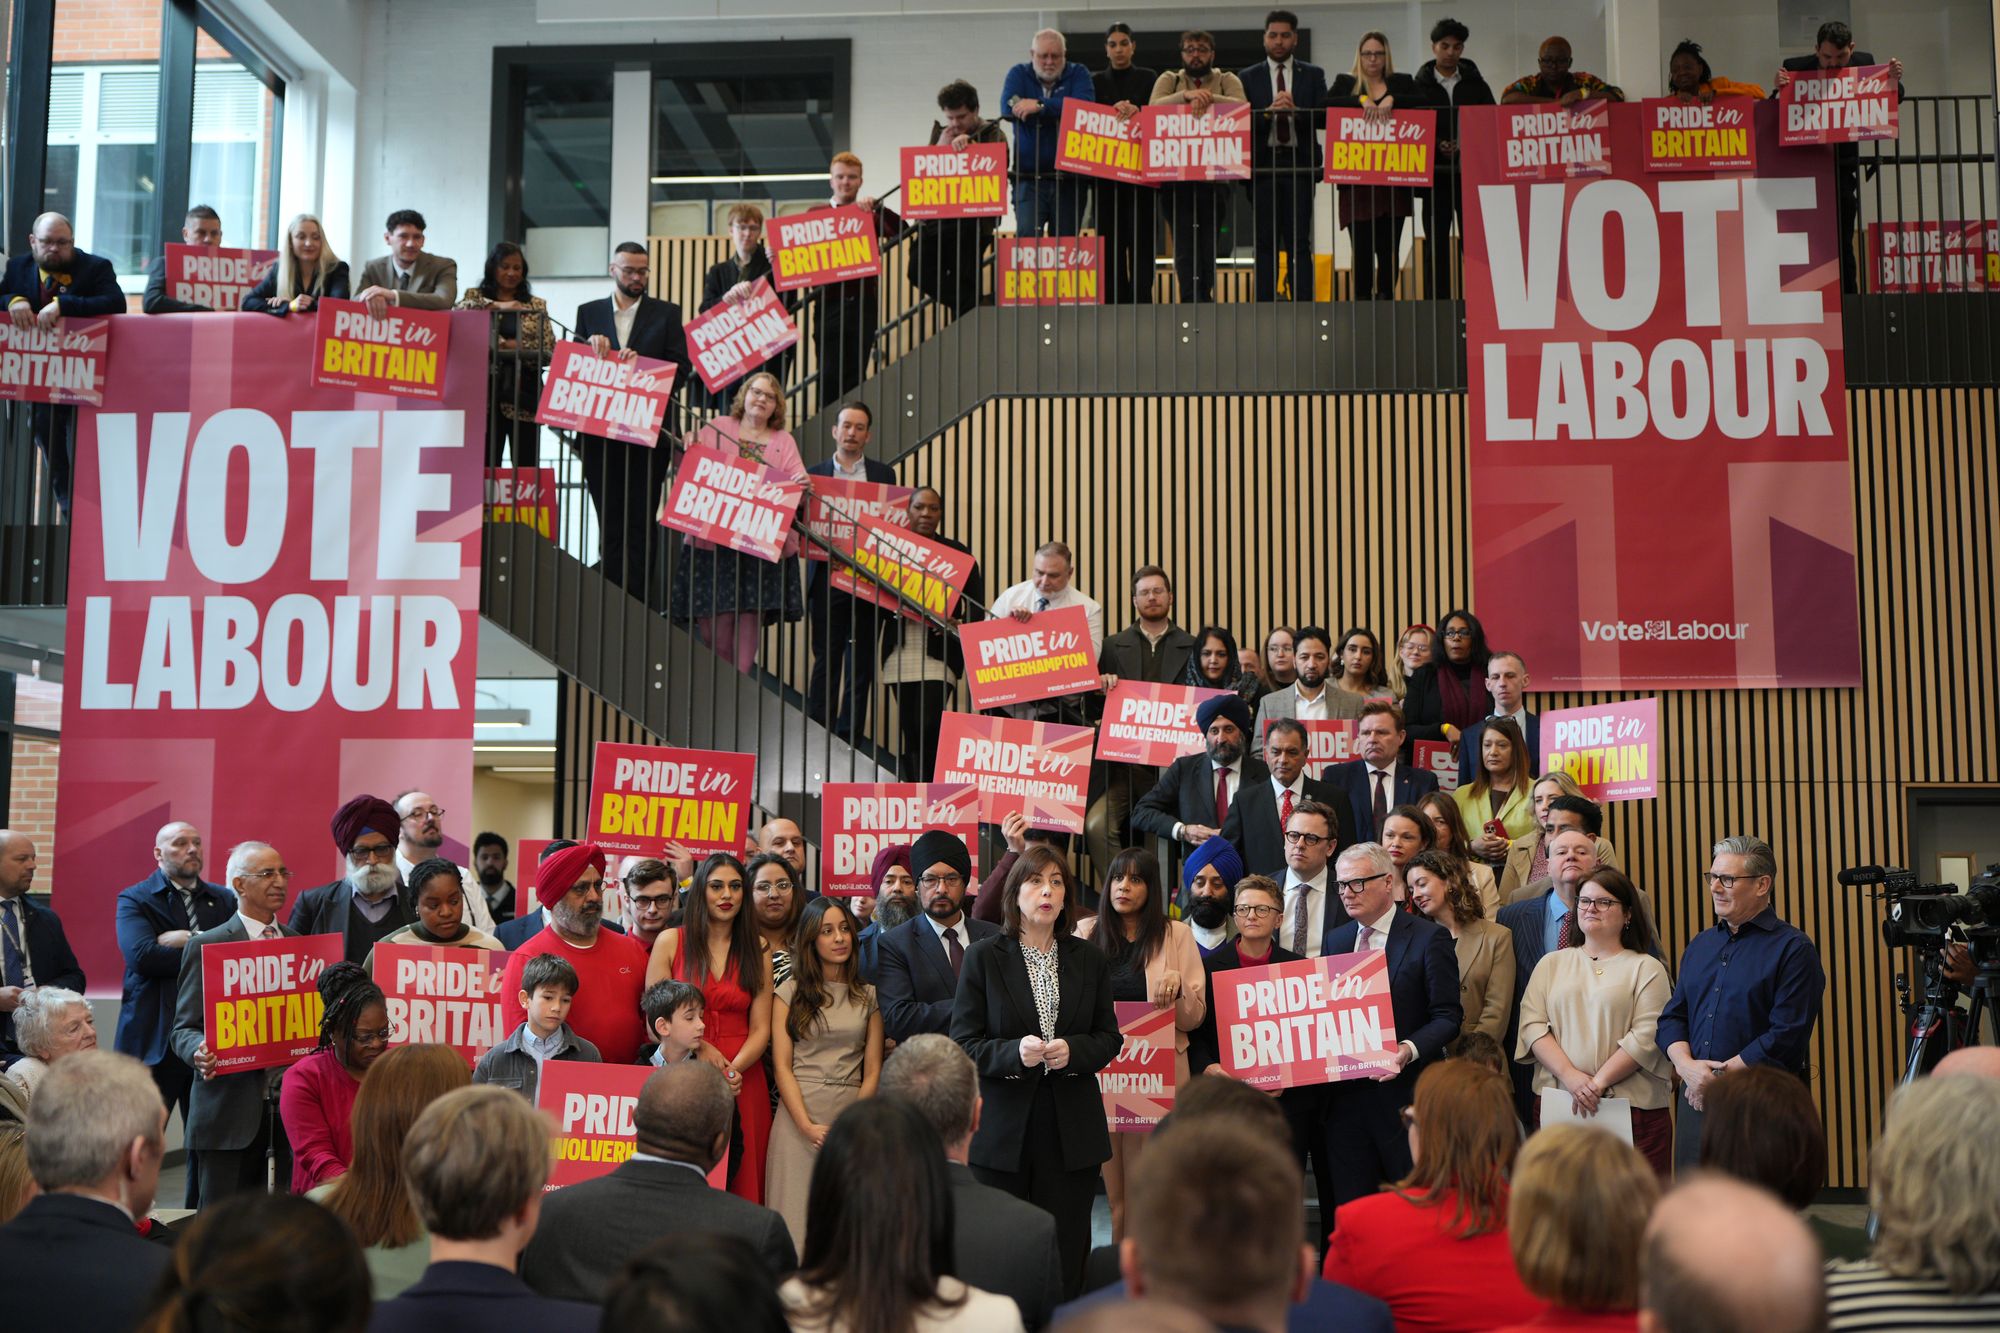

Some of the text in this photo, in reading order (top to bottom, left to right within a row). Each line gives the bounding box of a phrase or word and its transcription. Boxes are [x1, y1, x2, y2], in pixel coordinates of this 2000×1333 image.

[1794, 76, 1886, 102] PRIDE in
[1074, 108, 1142, 140] PRIDE i
[1156, 114, 1241, 137] PRIDE in
[1340, 118, 1426, 142] PRIDE in
[1512, 112, 1598, 138] PRIDE in
[1657, 106, 1744, 128] PRIDE in
[1787, 98, 1888, 132] BRITAIN
[1149, 136, 1242, 168] BRITAIN
[1332, 142, 1427, 173] BRITAIN
[1506, 133, 1602, 168] BRITAIN
[1651, 128, 1748, 158] BRITAIN
[914, 153, 997, 176] PRIDE in
[908, 175, 1000, 206] BRITAIN
[780, 216, 864, 248] PRIDE in
[1883, 230, 1940, 254] PRIDE
[182, 255, 248, 284] PRIDE
[778, 235, 872, 277] BRITAIN
[1011, 246, 1094, 269] PRIDE in
[1477, 176, 1824, 332] VOTE
[176, 282, 252, 312] BRIT
[1005, 270, 1097, 298] BRITAIN
[63, 330, 94, 352] in
[334, 310, 438, 346] PRIDE in
[690, 304, 747, 351] PRIDE
[698, 308, 789, 378] BRITAIN
[0, 351, 96, 391] RITAIN
[323, 338, 438, 384] BRITAIN
[564, 352, 661, 392] PRIDE in
[548, 378, 658, 430] BRITAIN
[1483, 337, 1834, 442] LABOUR
[96, 407, 466, 584] VOTE
[693, 456, 790, 506] PRIDE in
[674, 480, 784, 544] BRITAIN
[884, 506, 910, 528] in
[864, 527, 931, 570] PRIDE
[928, 554, 958, 580] in
[978, 630, 1079, 666] PRIDE in
[1581, 620, 1749, 642] Vote Labour
[80, 593, 462, 712] LABOUR
[976, 652, 1088, 684] WOLVERHAMPTON
[1120, 698, 1189, 728] PRIDE
[1109, 724, 1207, 747] WOLVERHAMPT
[1555, 716, 1646, 750] PRIDE in
[956, 737, 1078, 778] PRIDE in
[1548, 743, 1648, 786] BRITAIN
[614, 758, 738, 796] PRIDE in
[600, 792, 738, 842] BRITAIN
[844, 797, 964, 830] PRIDE in
[223, 954, 296, 997] PRIDE
[396, 959, 503, 998] PRIDE i
[1236, 973, 1372, 1020] PRIDE in
[386, 997, 505, 1048] BRITAI
[1230, 1006, 1383, 1070] BRITAIN
[290, 1048, 309, 1056] PRIDE
[1325, 1064, 1348, 1074] PRIDE
[1358, 1060, 1392, 1070] BRITAIN
[562, 1092, 639, 1136] PRID
[1107, 1116, 1125, 1124] RIDE
[1135, 1116, 1161, 1124] BRITA
